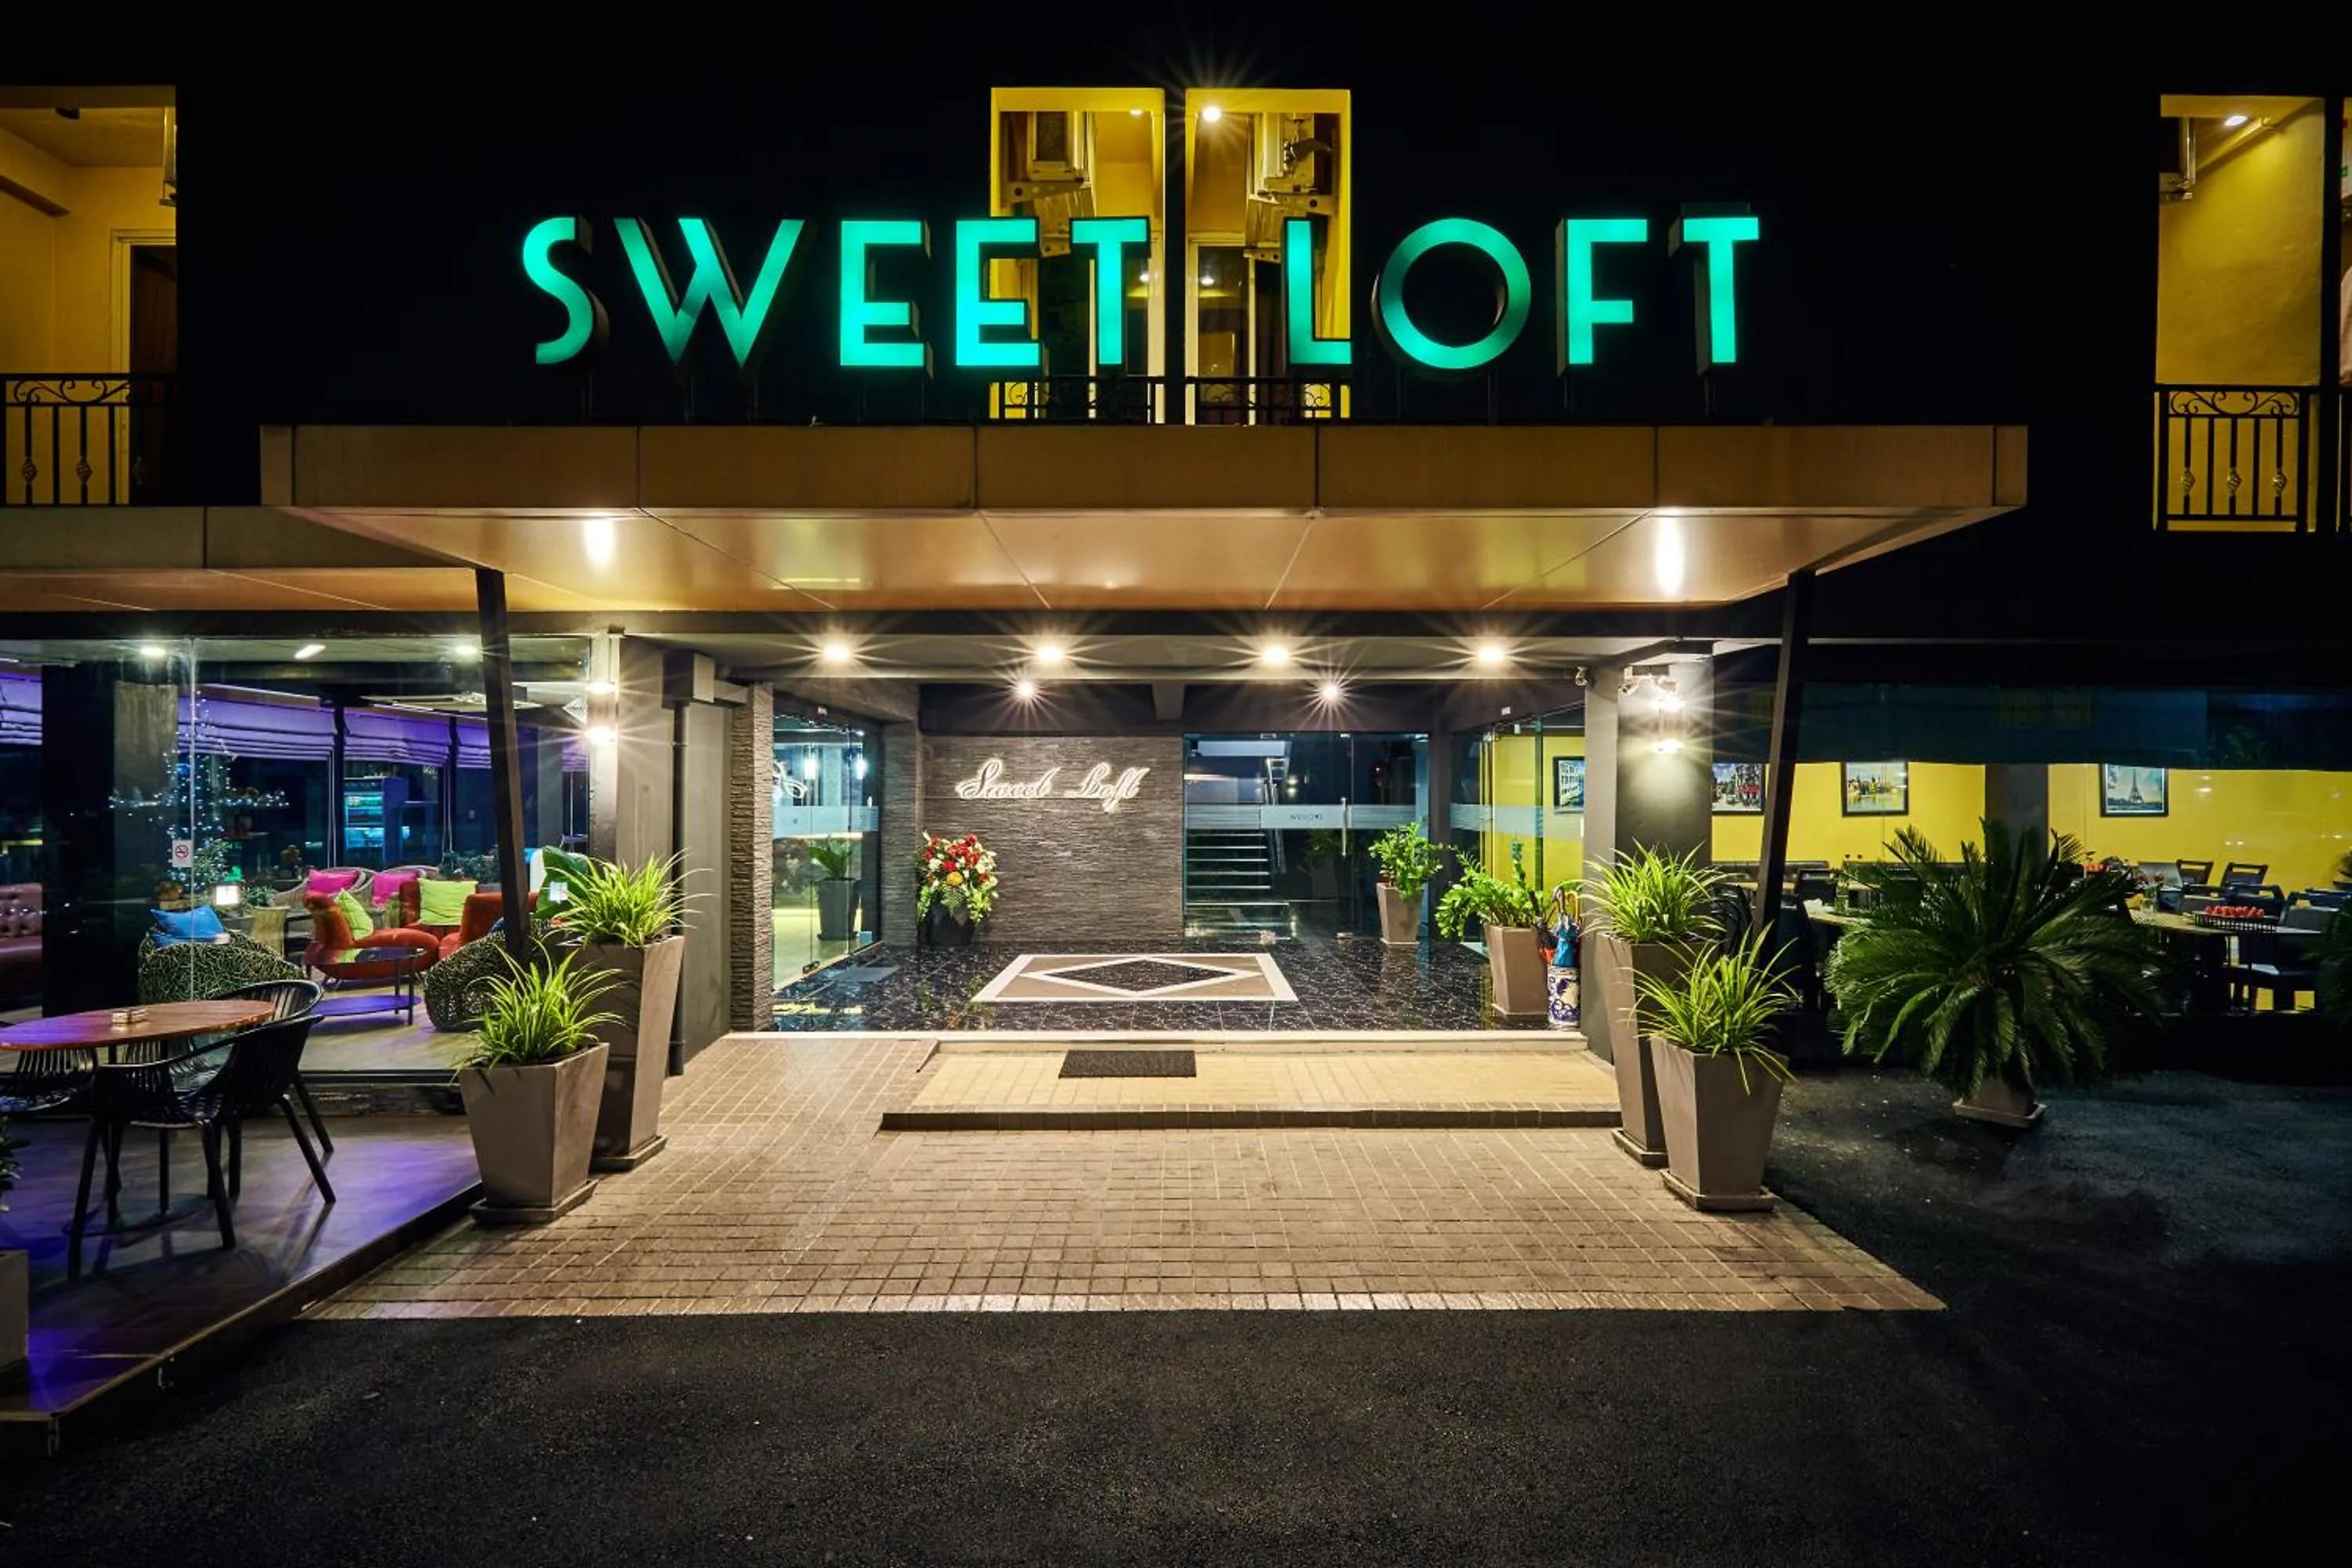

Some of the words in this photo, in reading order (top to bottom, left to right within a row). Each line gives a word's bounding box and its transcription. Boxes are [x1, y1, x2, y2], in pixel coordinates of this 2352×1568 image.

[522, 216, 1149, 368] SWEET
[1284, 216, 1760, 370] LOFT
[954, 757, 1061, 799] Sweet
[1063, 760, 1151, 813] Loft
